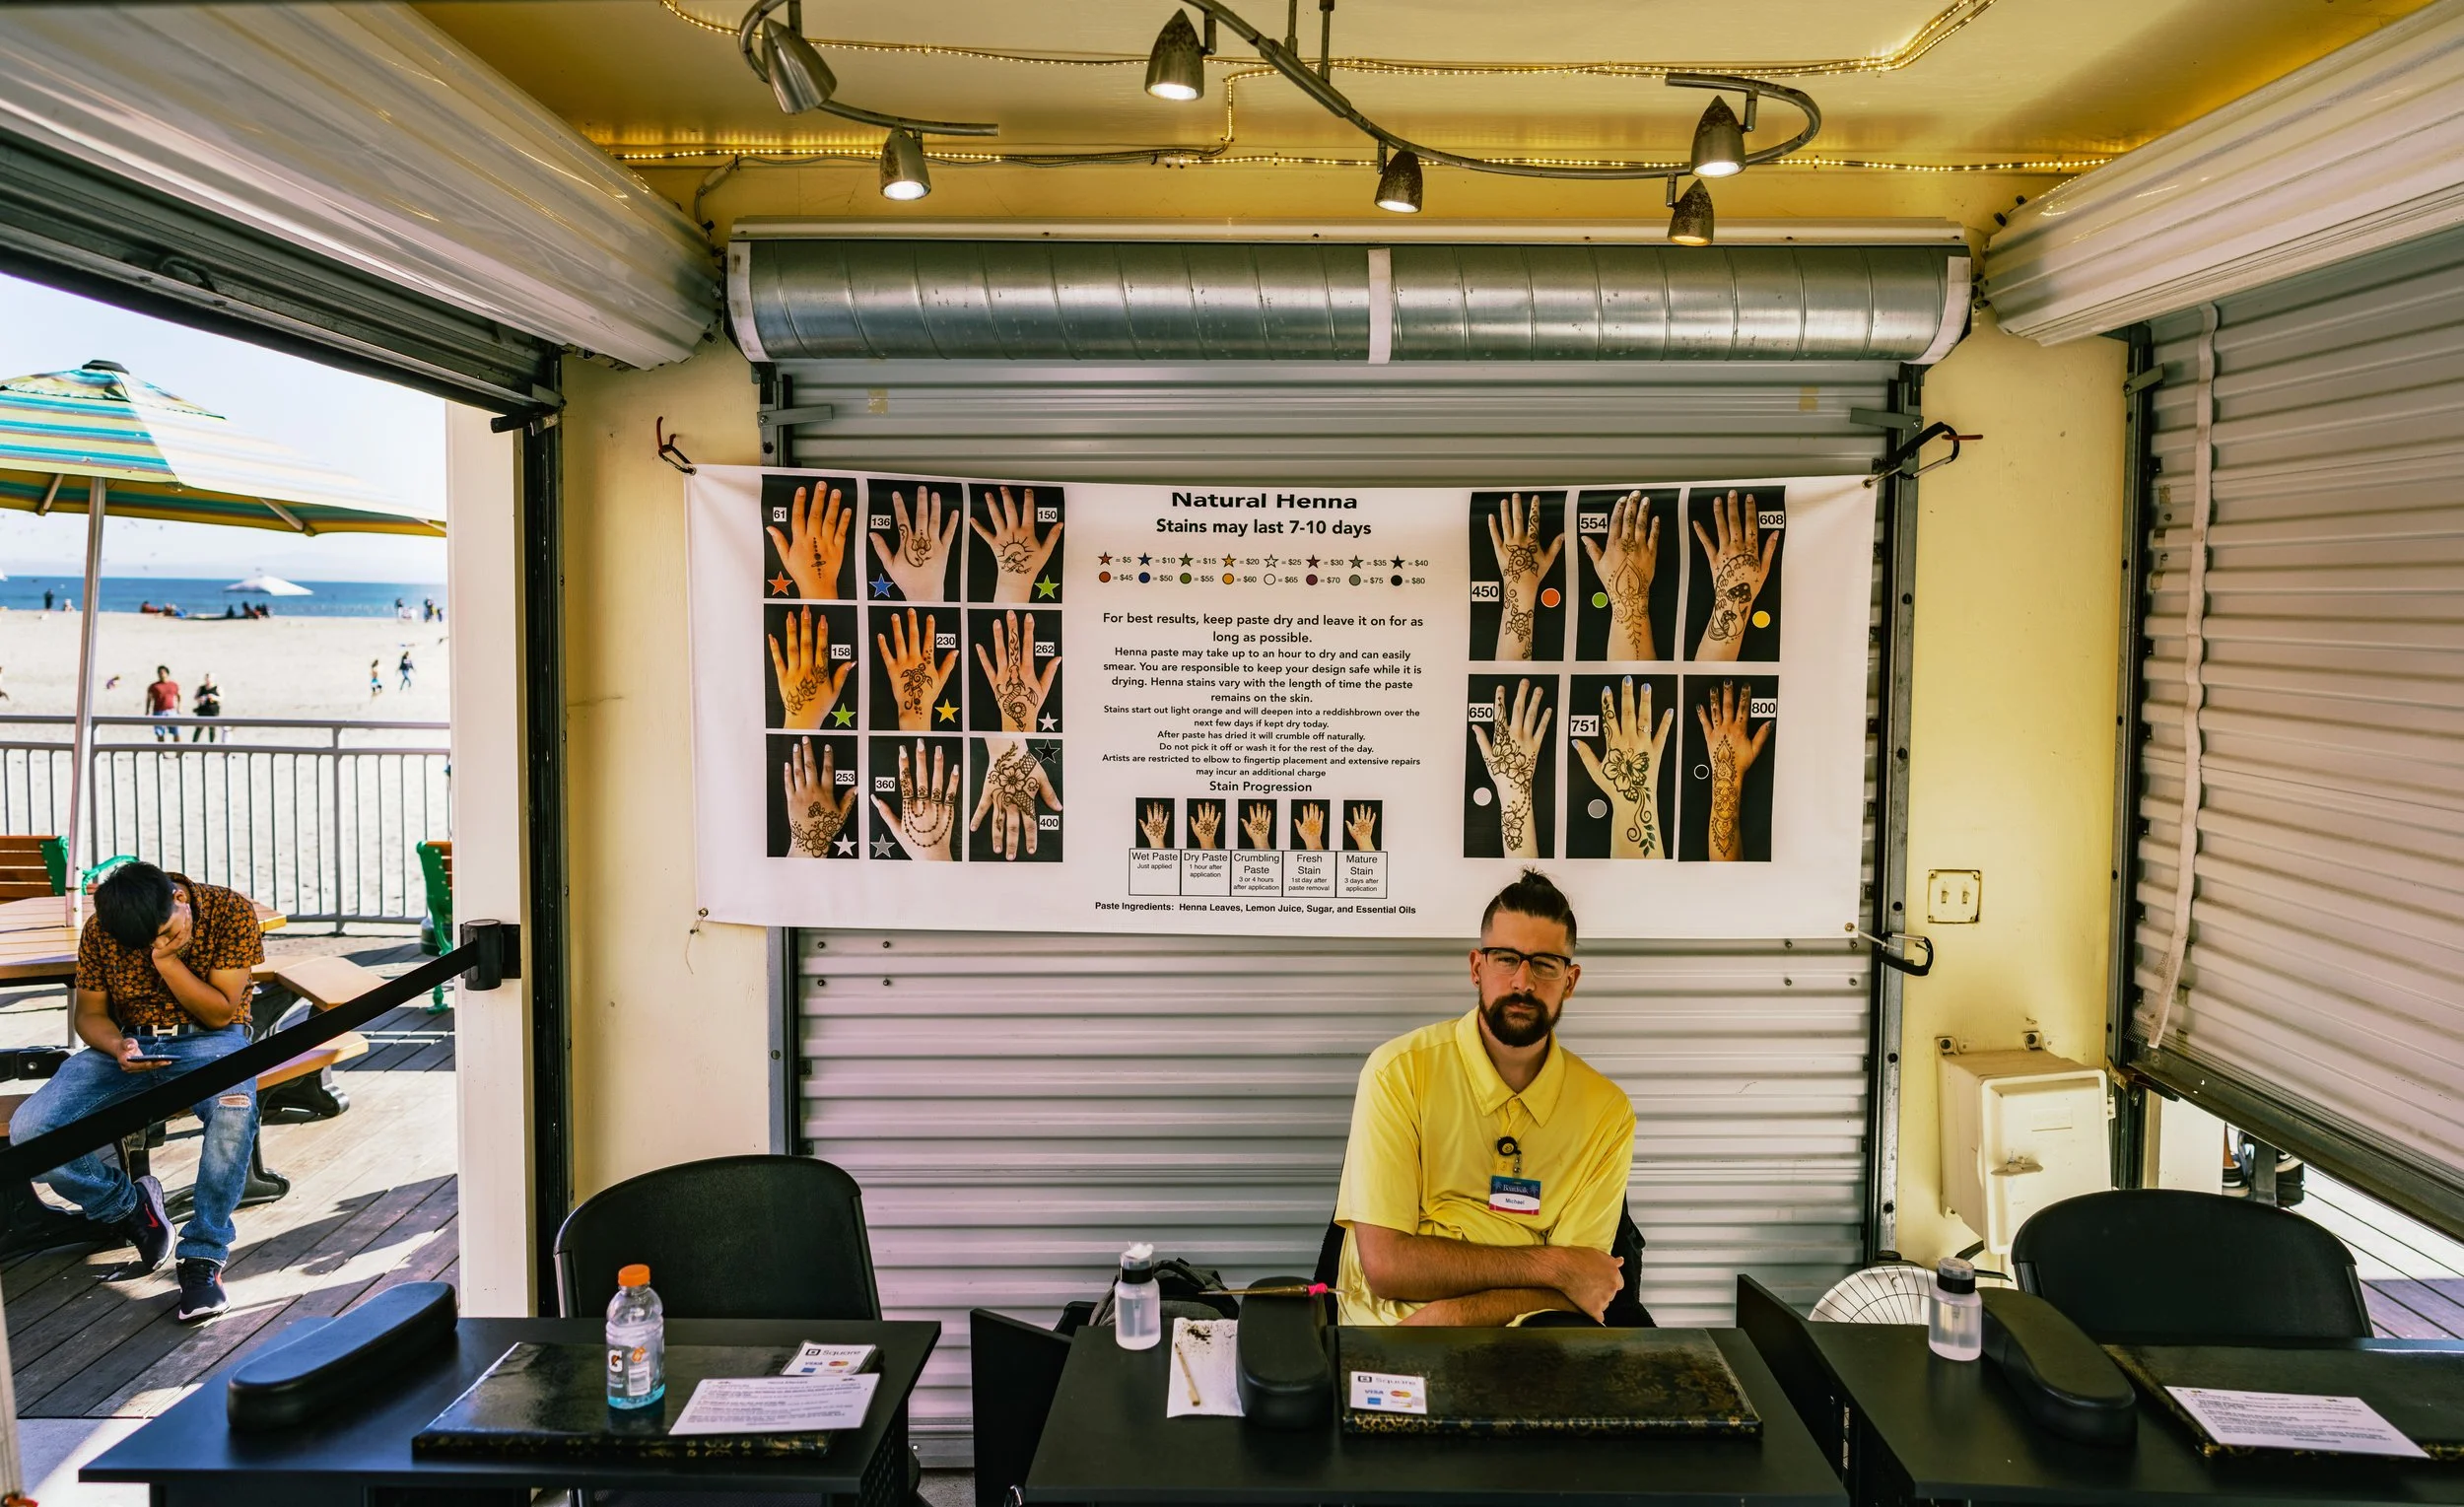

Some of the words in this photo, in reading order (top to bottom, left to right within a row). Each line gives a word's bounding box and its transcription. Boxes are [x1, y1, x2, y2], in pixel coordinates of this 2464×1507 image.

[1171, 492, 1266, 508] Natural
[1276, 494, 1357, 509] Henna
[774, 510, 787, 520] 61
[1038, 510, 1057, 520] 150
[1759, 514, 1784, 525] 608
[871, 517, 890, 527] 136
[1580, 517, 1608, 530] 554
[1156, 518, 1206, 532] Stains
[1212, 522, 1248, 537] may
[1254, 518, 1283, 533] last
[1288, 519, 1326, 534] 7-10
[1332, 519, 1371, 538] days
[1472, 586, 1499, 598] 450
[1103, 612, 1124, 623] For
[1127, 612, 1153, 623] best
[1156, 613, 1198, 625] results,
[1202, 613, 1232, 627] keep
[1236, 615, 1269, 627] paste
[1273, 614, 1293, 628] dry
[1296, 614, 1319, 625] and
[1323, 614, 1354, 625] leave
[1358, 615, 1366, 626] it
[1389, 614, 1407, 626] for
[936, 636, 955, 647] 230
[1212, 631, 1239, 645] long
[1260, 631, 1312, 645] possible.
[832, 647, 851, 657] 158
[1036, 645, 1054, 654] 262
[1115, 647, 1147, 656] Henna
[1150, 649, 1179, 658] paste
[1182, 650, 1203, 659] may
[1205, 648, 1228, 656] take
[1232, 651, 1245, 659] up
[1277, 649, 1302, 657] hour
[1304, 650, 1316, 658] to
[1319, 649, 1335, 660] dry
[1338, 649, 1358, 658] and
[1382, 650, 1410, 661] easily
[1138, 661, 1158, 671] You
[1181, 662, 1240, 673] responsible
[1257, 662, 1282, 674] keep
[1285, 666, 1309, 675] your
[1311, 663, 1345, 675] design
[1348, 663, 1370, 673] safe
[1372, 664, 1400, 674] while
[1403, 664, 1410, 674] it
[1413, 664, 1421, 674] is
[1469, 708, 1493, 719] 650
[1750, 703, 1776, 714] 800
[1571, 719, 1598, 732] 751
[1156, 729, 1180, 738] After
[1182, 731, 1205, 740] paste
[1224, 730, 1247, 739] dried
[1327, 732, 1365, 742] naturally.
[1102, 753, 1129, 762] Artists
[1243, 755, 1280, 765] fingertip
[1282, 756, 1328, 765] placement
[1391, 757, 1420, 767] repairs
[836, 773, 855, 783] 253
[1296, 768, 1326, 779] charge
[875, 780, 895, 789] 360
[1209, 781, 1238, 790] Stain
[1243, 781, 1312, 793] Progression
[1040, 818, 1059, 828] 400
[1131, 852, 1149, 860] Wet
[1152, 852, 1179, 860] Paste
[1184, 853, 1199, 863] Dry
[1201, 853, 1228, 861] Paste
[1234, 854, 1279, 863] Crumbling
[1296, 854, 1322, 862] Fresh
[1345, 855, 1377, 863] Mature
[1244, 864, 1269, 874] Paste
[1297, 865, 1321, 874] Stain
[1349, 866, 1373, 875] Stain
[1095, 901, 1120, 910] Paste
[1122, 902, 1174, 912] Ingredients:
[1209, 903, 1243, 912] Leaves,
[1277, 904, 1304, 913] Juice,
[1306, 904, 1335, 914] Sugar,
[1355, 905, 1396, 914] Essential
[1398, 905, 1415, 914] Oils
